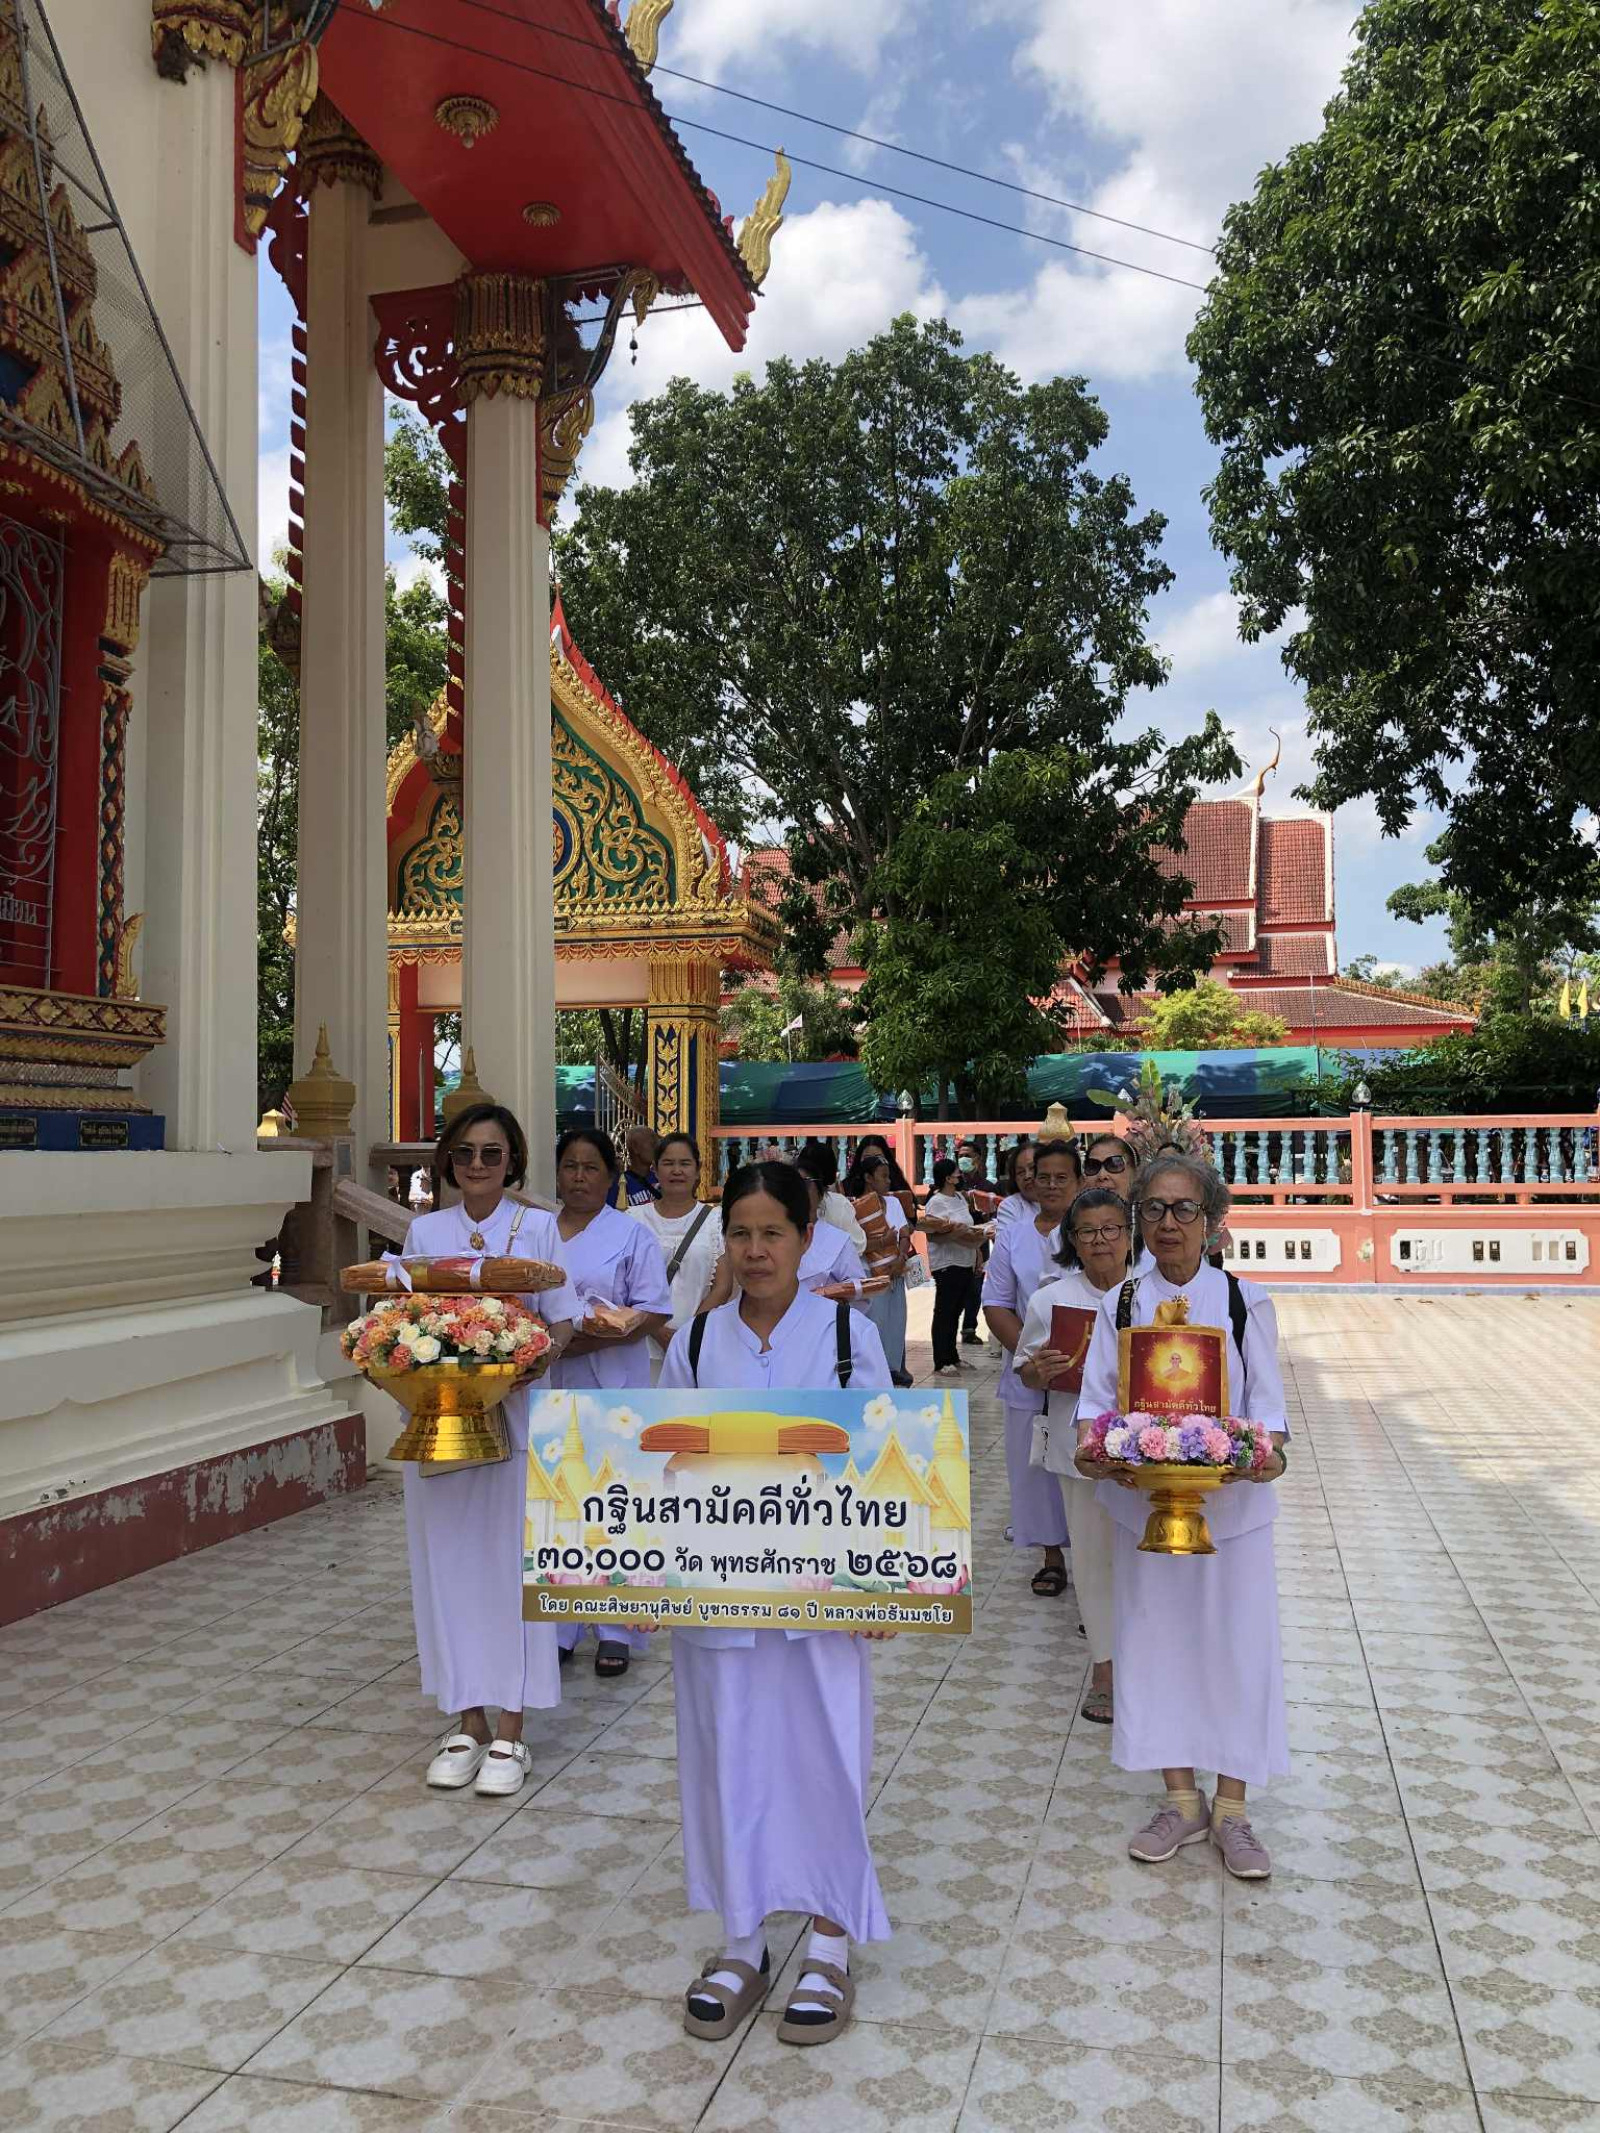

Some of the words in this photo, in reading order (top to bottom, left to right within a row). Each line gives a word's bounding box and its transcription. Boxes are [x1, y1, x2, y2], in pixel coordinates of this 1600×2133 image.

[583, 1475, 907, 1535] กฐินสามัคคีทั่วไทย
[537, 1547, 665, 1575] ๓๐,๐๐๐
[675, 1546, 703, 1572] วัด
[711, 1548, 835, 1582] พุทธศักราช
[847, 1549, 958, 1579] ๒๕๖๘
[540, 1595, 568, 1611] โดย
[574, 1597, 693, 1620] คณะศิษยานุศิษย์
[699, 1603, 771, 1621] บูชาธรรม
[778, 1604, 800, 1619] ๘๑
[807, 1600, 818, 1618] ปี
[824, 1602, 952, 1623] หลวงพ่อธัมมชโย
